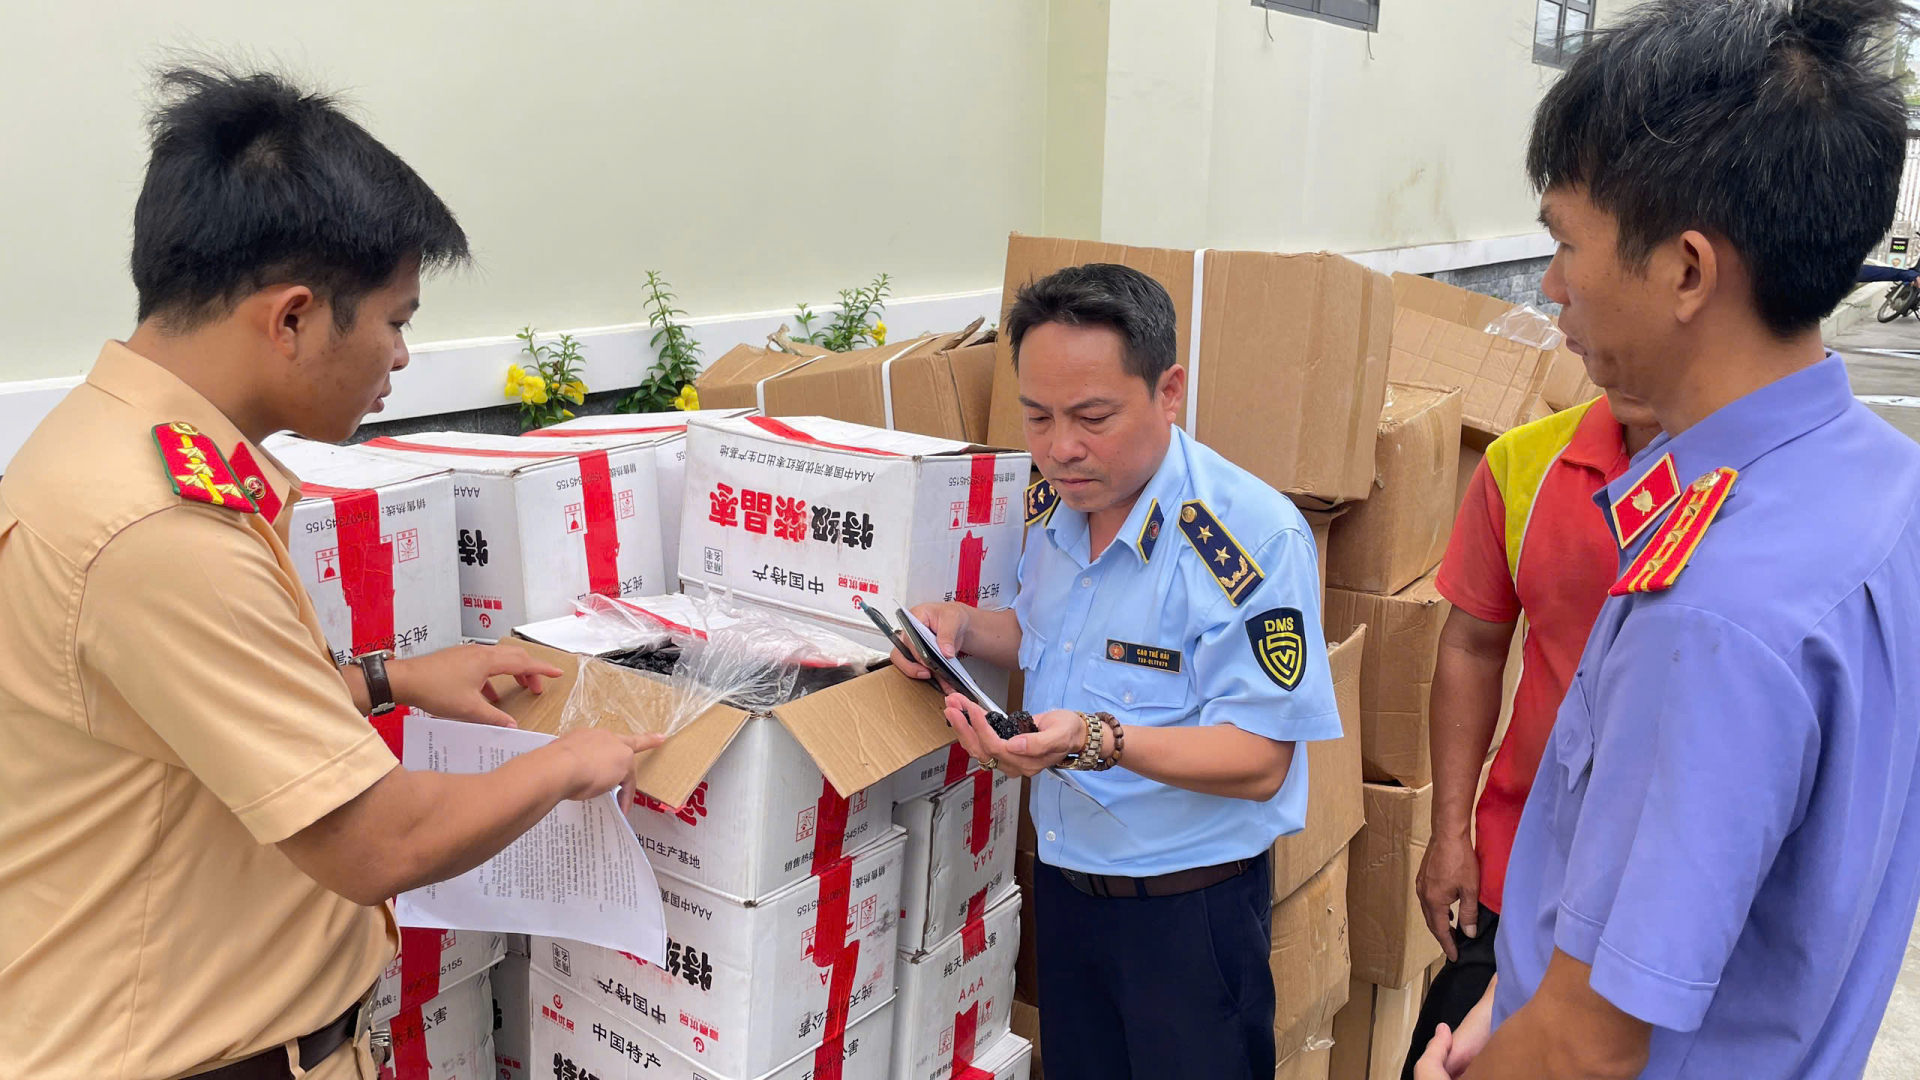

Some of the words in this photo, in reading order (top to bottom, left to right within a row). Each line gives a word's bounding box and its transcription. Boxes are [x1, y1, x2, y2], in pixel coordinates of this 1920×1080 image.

[719, 444, 876, 483] AAA中国黄河优质红枣出口生产基地
[457, 528, 489, 567] 特
[752, 564, 824, 595] 中国特产
[1264, 616, 1294, 633] DMS
[597, 978, 667, 1025] 中国特产
[592, 1022, 662, 1069] 中国特产
